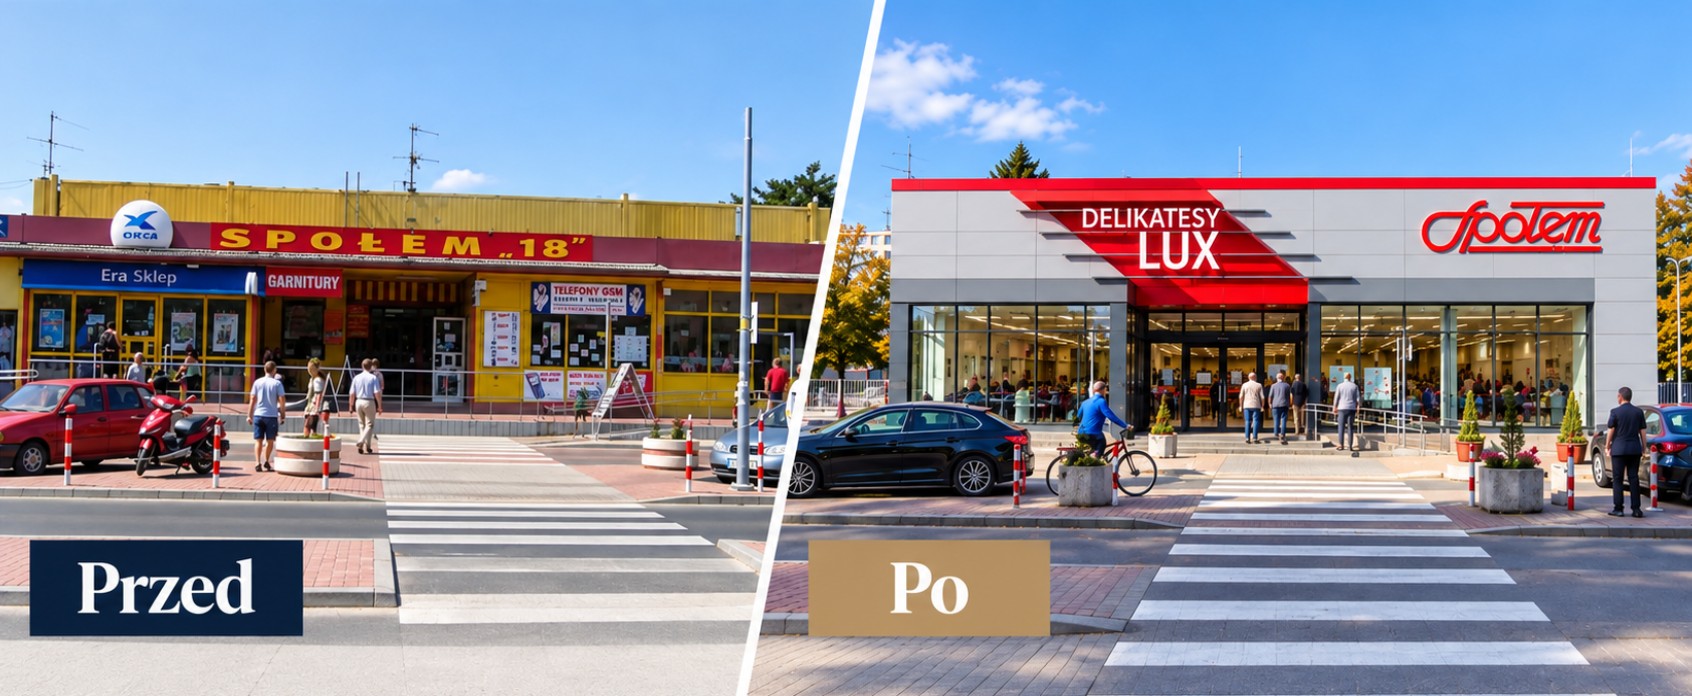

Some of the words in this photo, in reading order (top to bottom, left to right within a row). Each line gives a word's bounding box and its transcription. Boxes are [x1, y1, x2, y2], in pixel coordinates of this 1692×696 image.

[1082, 208, 1220, 229] DELIKATESY
[219, 227, 482, 257] SPOŁEM
[1139, 231, 1220, 270] LUX
[101, 268, 128, 283] Era
[133, 269, 177, 288] Sklep
[267, 274, 340, 290] GARNITURY
[553, 285, 599, 296] TELEFONY
